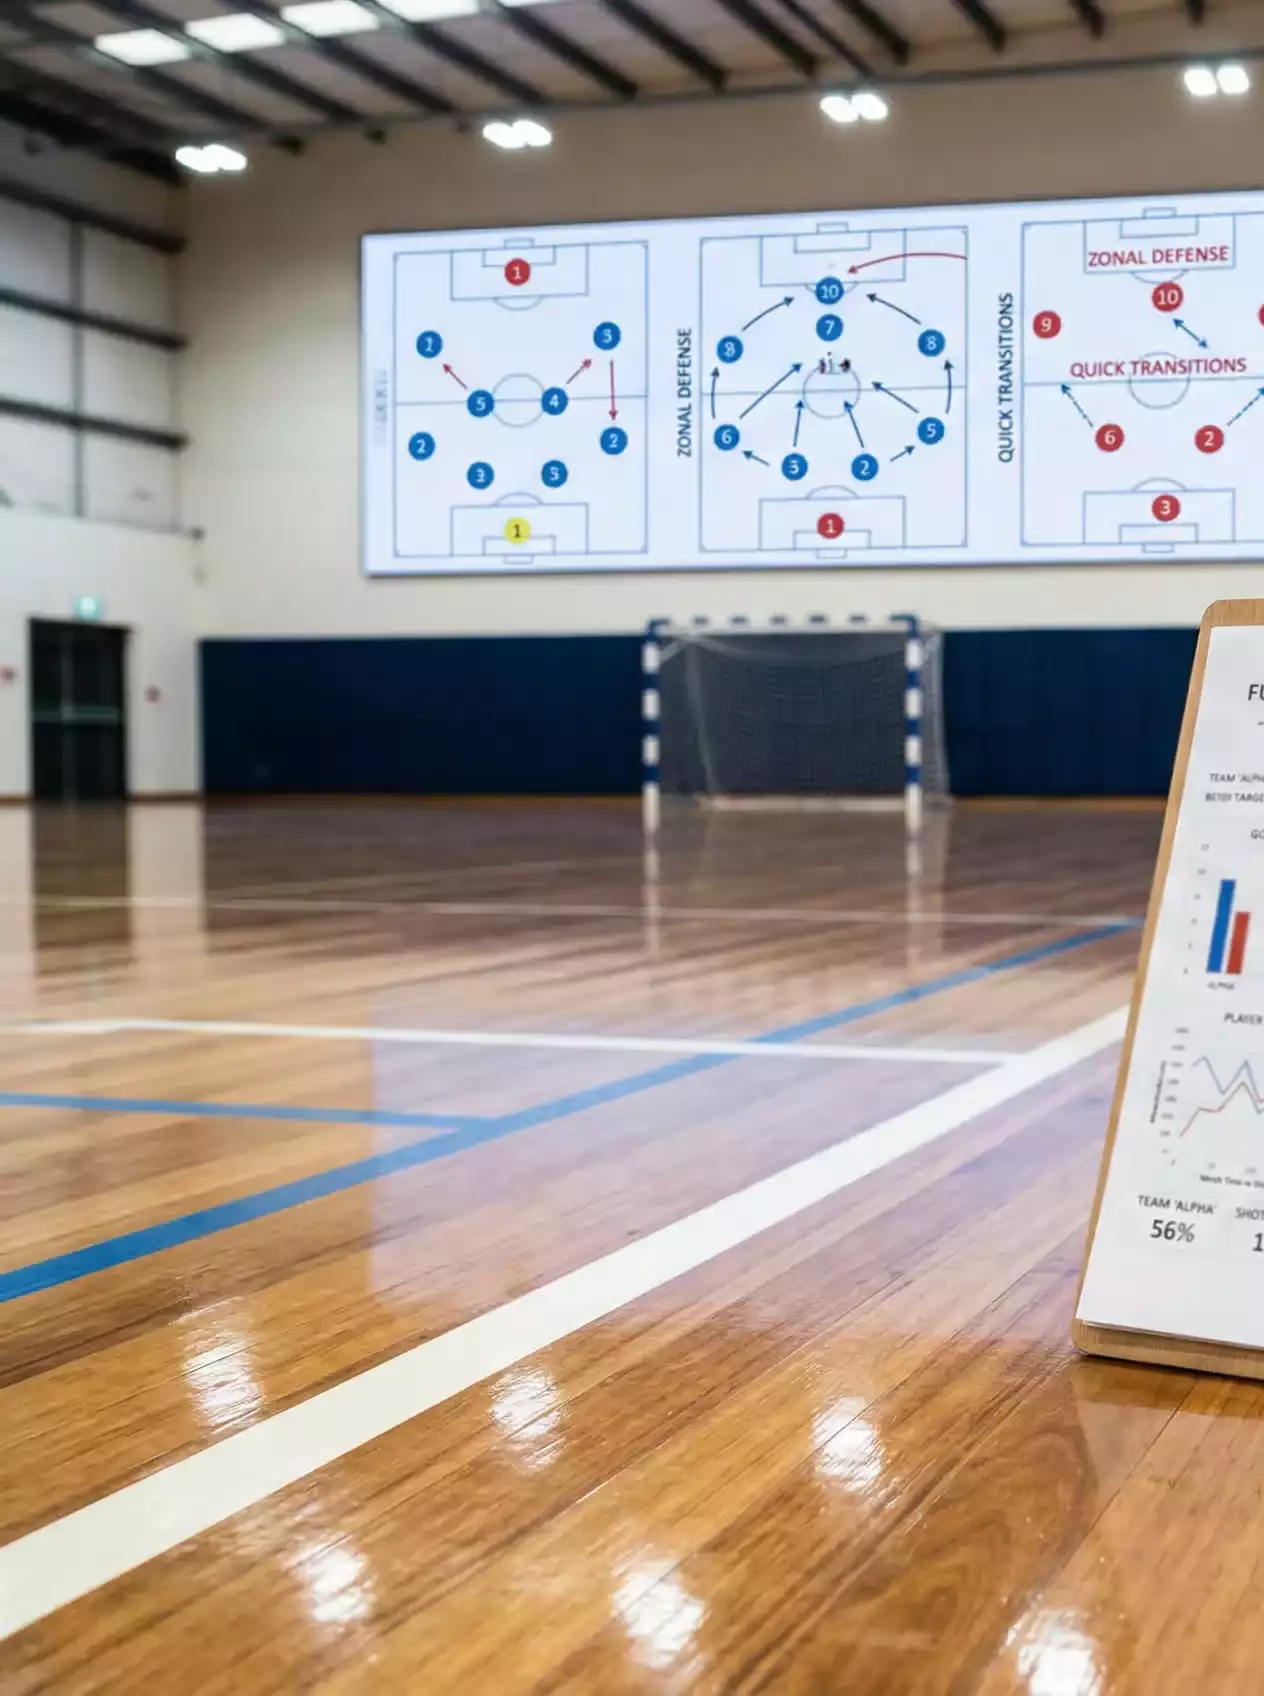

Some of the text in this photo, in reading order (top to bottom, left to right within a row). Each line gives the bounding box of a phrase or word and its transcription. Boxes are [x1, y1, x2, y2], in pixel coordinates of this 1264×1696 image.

[1088, 245, 1229, 267] ZONAL DEFENSE
[513, 266, 522, 280] 1
[820, 284, 839, 299] 10
[1157, 289, 1179, 304] 10
[825, 320, 834, 335] 7
[1040, 318, 1053, 333] 9
[925, 336, 937, 351] 8
[1070, 358, 1247, 378] QUICK TRANSITIONS
[998, 292, 1014, 463] QUICK TRANSITIONS
[677, 327, 692, 457] ZONAL DEFENSE
[475, 397, 485, 411] 5
[549, 394, 559, 408] 4
[721, 429, 732, 444] 6
[926, 423, 936, 438] 5
[1104, 430, 1115, 445] 6
[416, 439, 426, 453] 2
[608, 433, 618, 448] 2
[1204, 432, 1214, 446] 2
[860, 460, 870, 475] 2
[1160, 500, 1171, 515] 3
[513, 524, 521, 538] 1
[826, 519, 836, 533] 1
[1209, 773, 1236, 782] TEAM
[1224, 1012, 1263, 1026] PLAYER
[1138, 1195, 1171, 1209] TEAM
[1150, 1218, 1195, 1243] 56%
